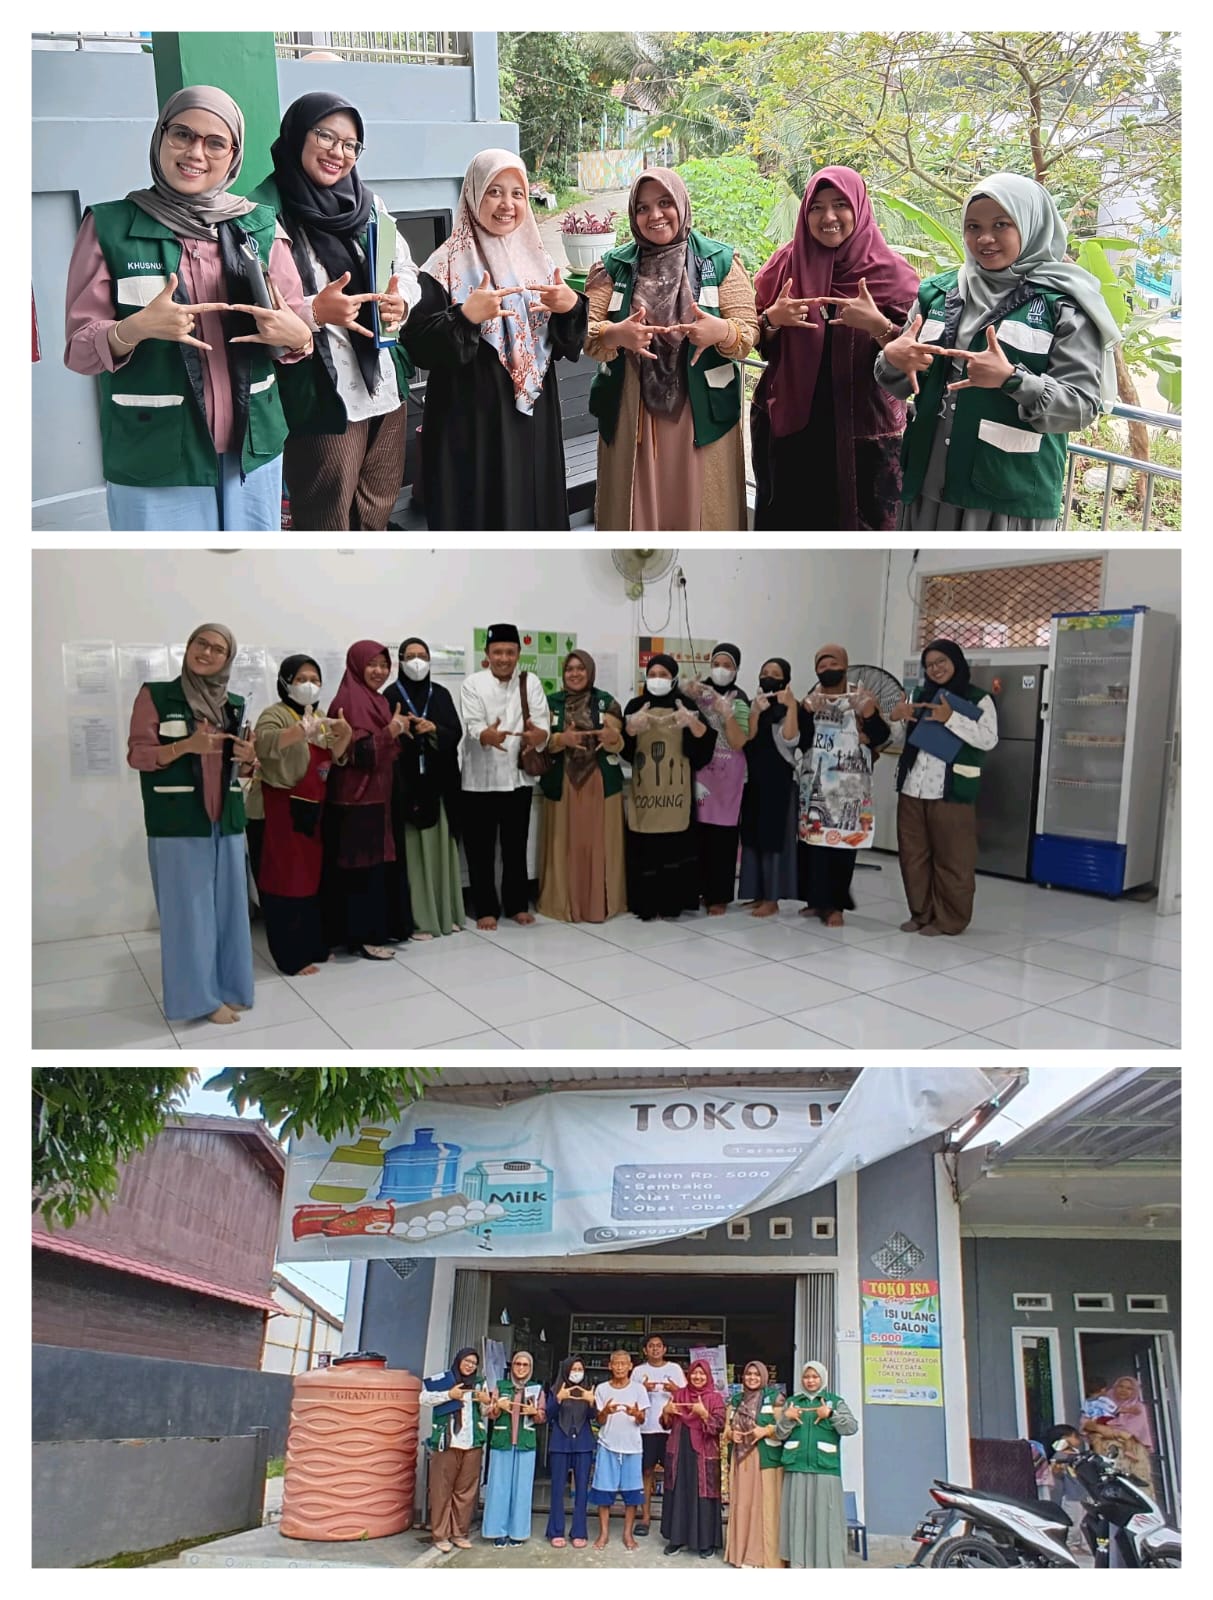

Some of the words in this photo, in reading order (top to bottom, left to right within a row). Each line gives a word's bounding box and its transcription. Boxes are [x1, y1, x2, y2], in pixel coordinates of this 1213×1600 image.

[815, 733, 835, 752] RIS
[635, 794, 684, 809] COOKING
[629, 1101, 779, 1132] TOKO
[635, 1171, 683, 1180] Galon
[725, 1170, 771, 1178] 5000
[634, 1182, 713, 1190] Sembako
[489, 1191, 548, 1204] Milk
[633, 1204, 675, 1212] Obat
[868, 1282, 906, 1297] TOKO
[910, 1282, 931, 1295] ISA
[885, 1309, 899, 1319] ISI
[901, 1310, 937, 1323] ULANG
[893, 1322, 929, 1334] GALON
[871, 1333, 902, 1342] 5.000
[336, 1390, 375, 1400] GRAND
